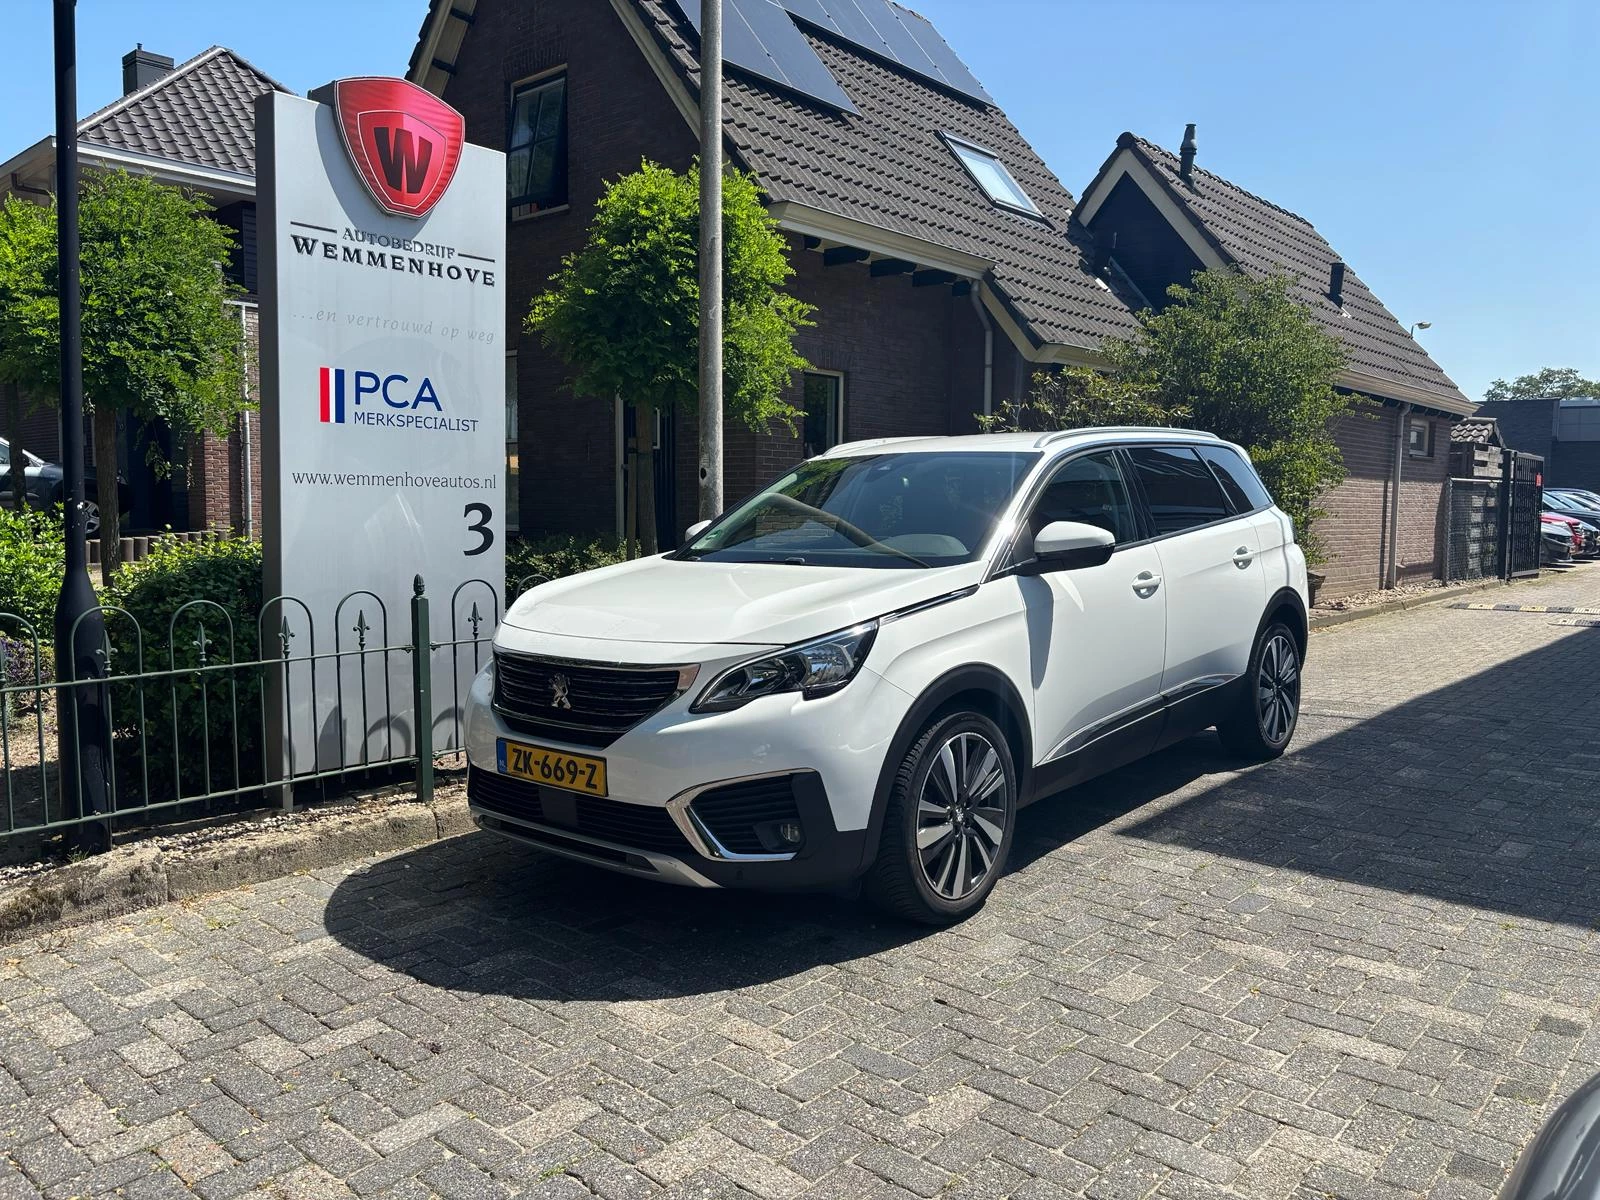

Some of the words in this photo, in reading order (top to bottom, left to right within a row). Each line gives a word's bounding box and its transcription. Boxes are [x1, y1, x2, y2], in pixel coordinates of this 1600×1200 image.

[291, 234, 496, 287] WEMMENHOVE
[342, 227, 456, 259] AUTOBEDRIJF
[347, 313, 434, 335] vertrouwd
[441, 326, 460, 341] op
[467, 329, 495, 345] weg
[354, 371, 443, 412] PCA
[354, 411, 479, 432] MERKSPECIALIST
[292, 472, 497, 489] www.wemmenhoveautos.nl
[463, 502, 495, 556] 3
[512, 748, 597, 789] ZK-669-Z
